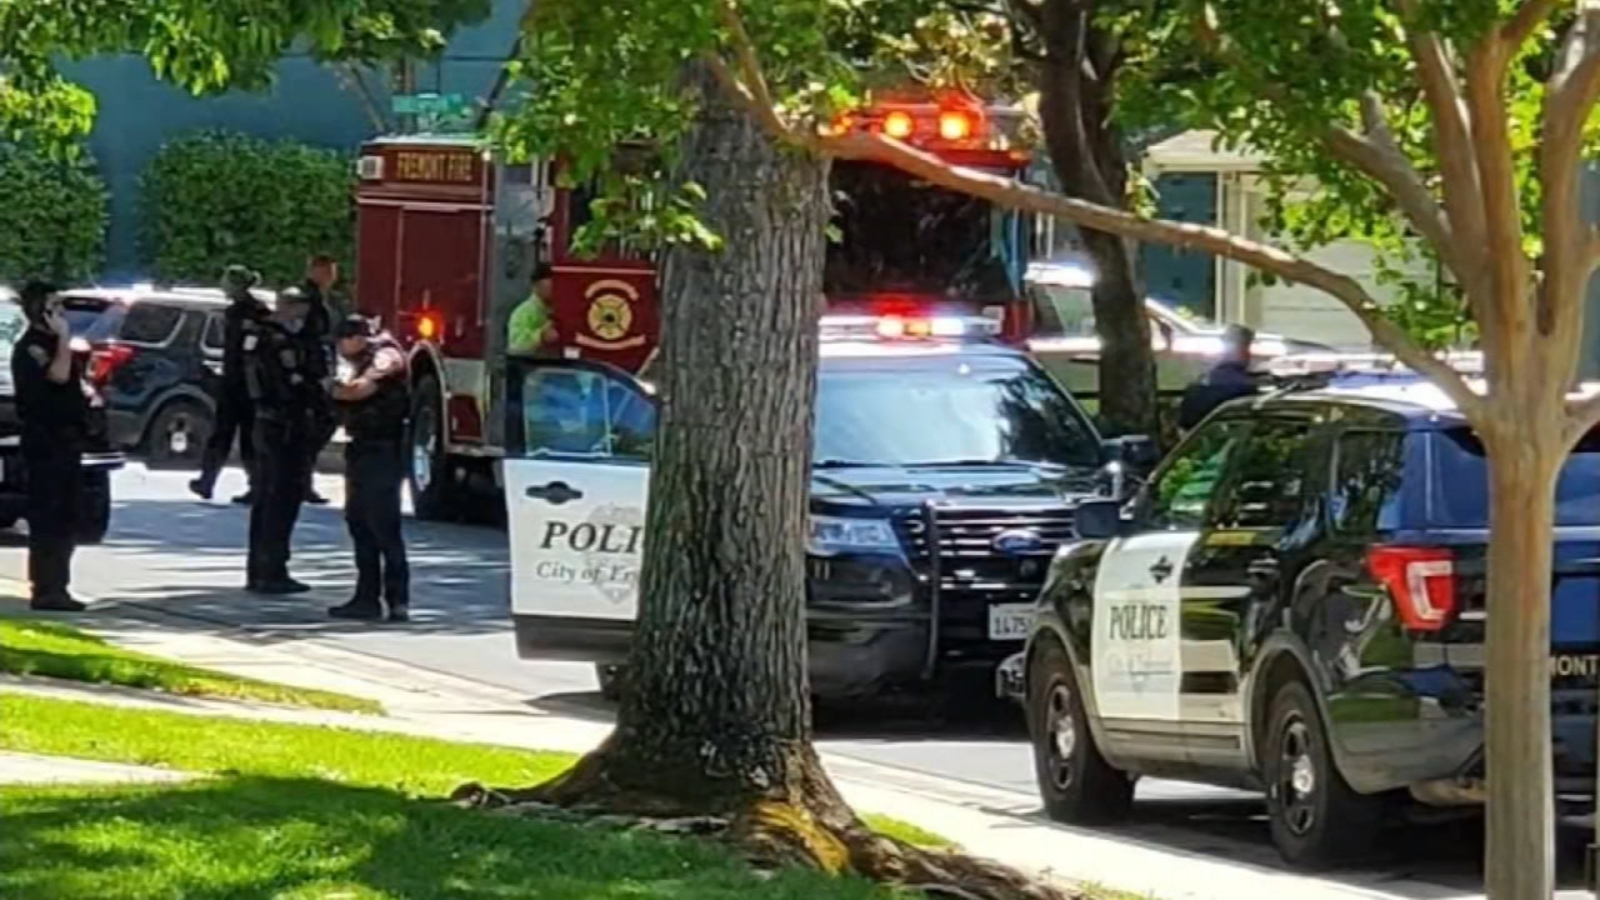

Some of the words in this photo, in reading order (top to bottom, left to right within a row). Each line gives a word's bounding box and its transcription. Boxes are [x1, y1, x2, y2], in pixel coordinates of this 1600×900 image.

[539, 520, 644, 553] POLI
[536, 560, 576, 585] City
[581, 565, 601, 586] of
[1109, 604, 1167, 640] POLICE
